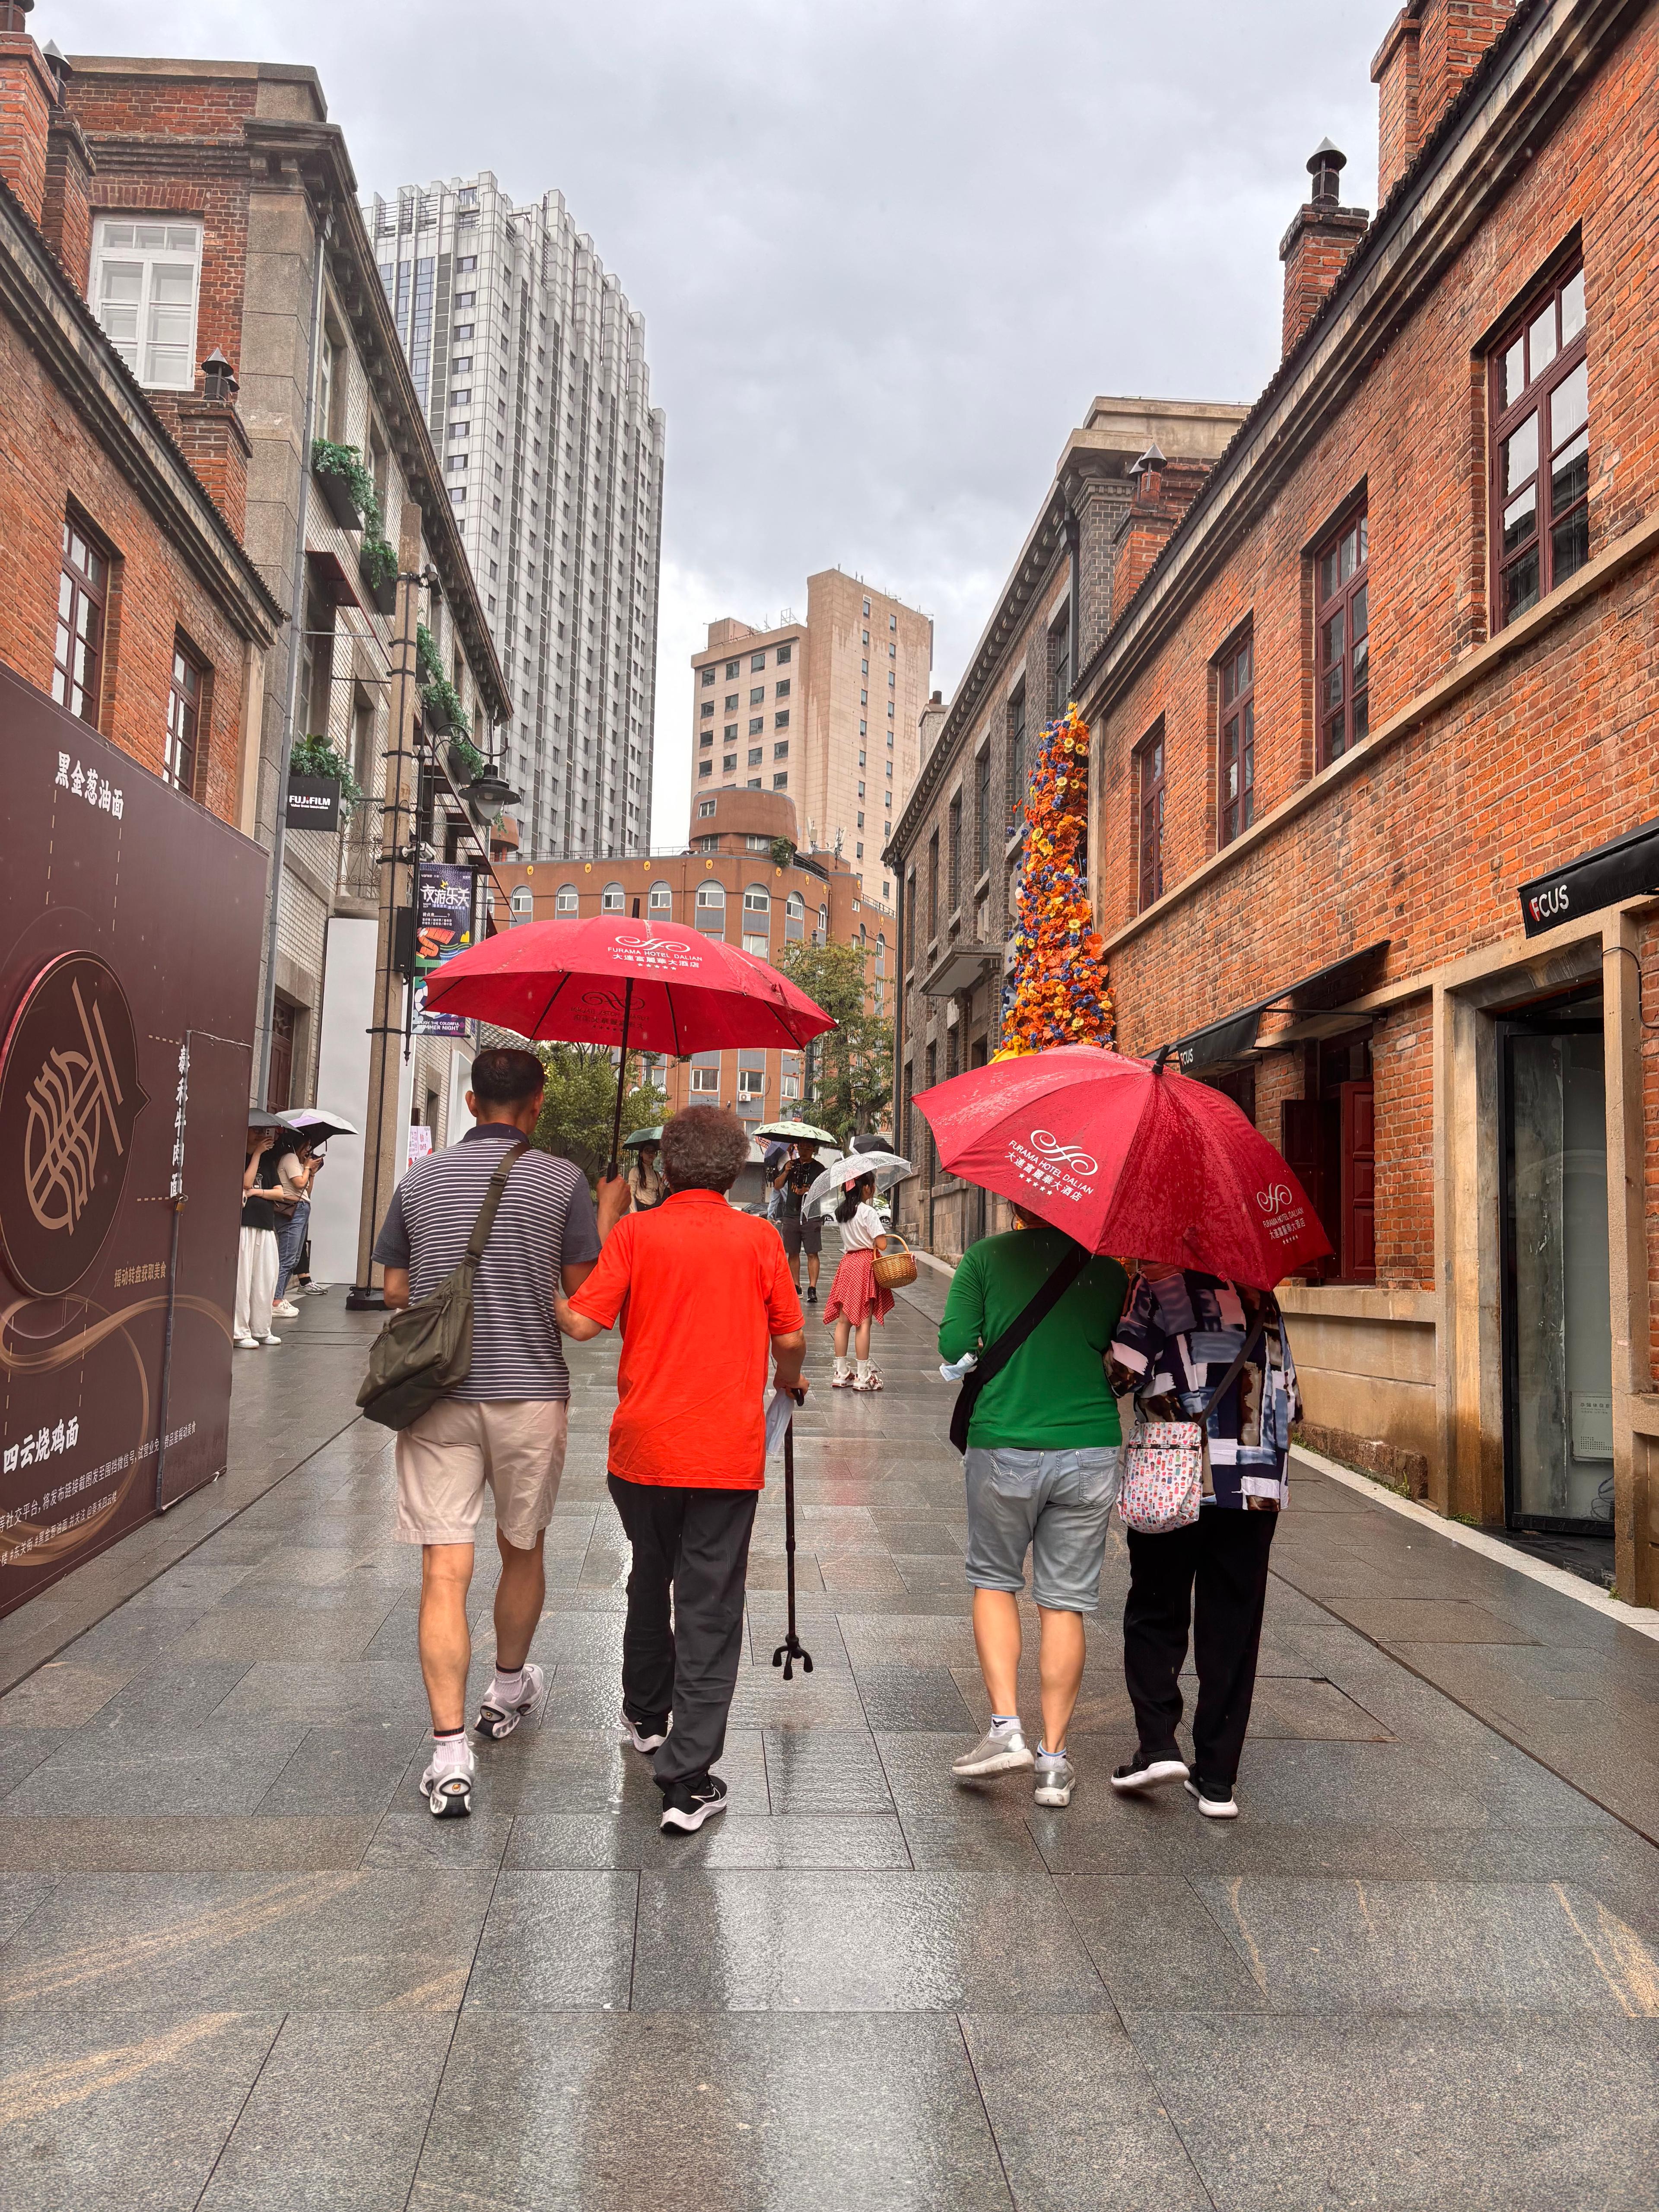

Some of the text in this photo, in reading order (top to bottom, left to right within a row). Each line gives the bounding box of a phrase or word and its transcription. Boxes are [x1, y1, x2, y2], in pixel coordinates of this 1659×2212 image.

[55, 751, 124, 820] 黑金葱油面
[289, 795, 331, 806] FUJIFILM
[607, 947, 641, 955] FURAMA
[1004, 1151, 1083, 1202] 大連富麗華大酒店
[1008, 1140, 1094, 1195] FURAMA HOTEL DALIAN
[114, 1261, 166, 1288] 摇动转盘获取美食
[3, 1416, 79, 1474] 四云烧鸡面
